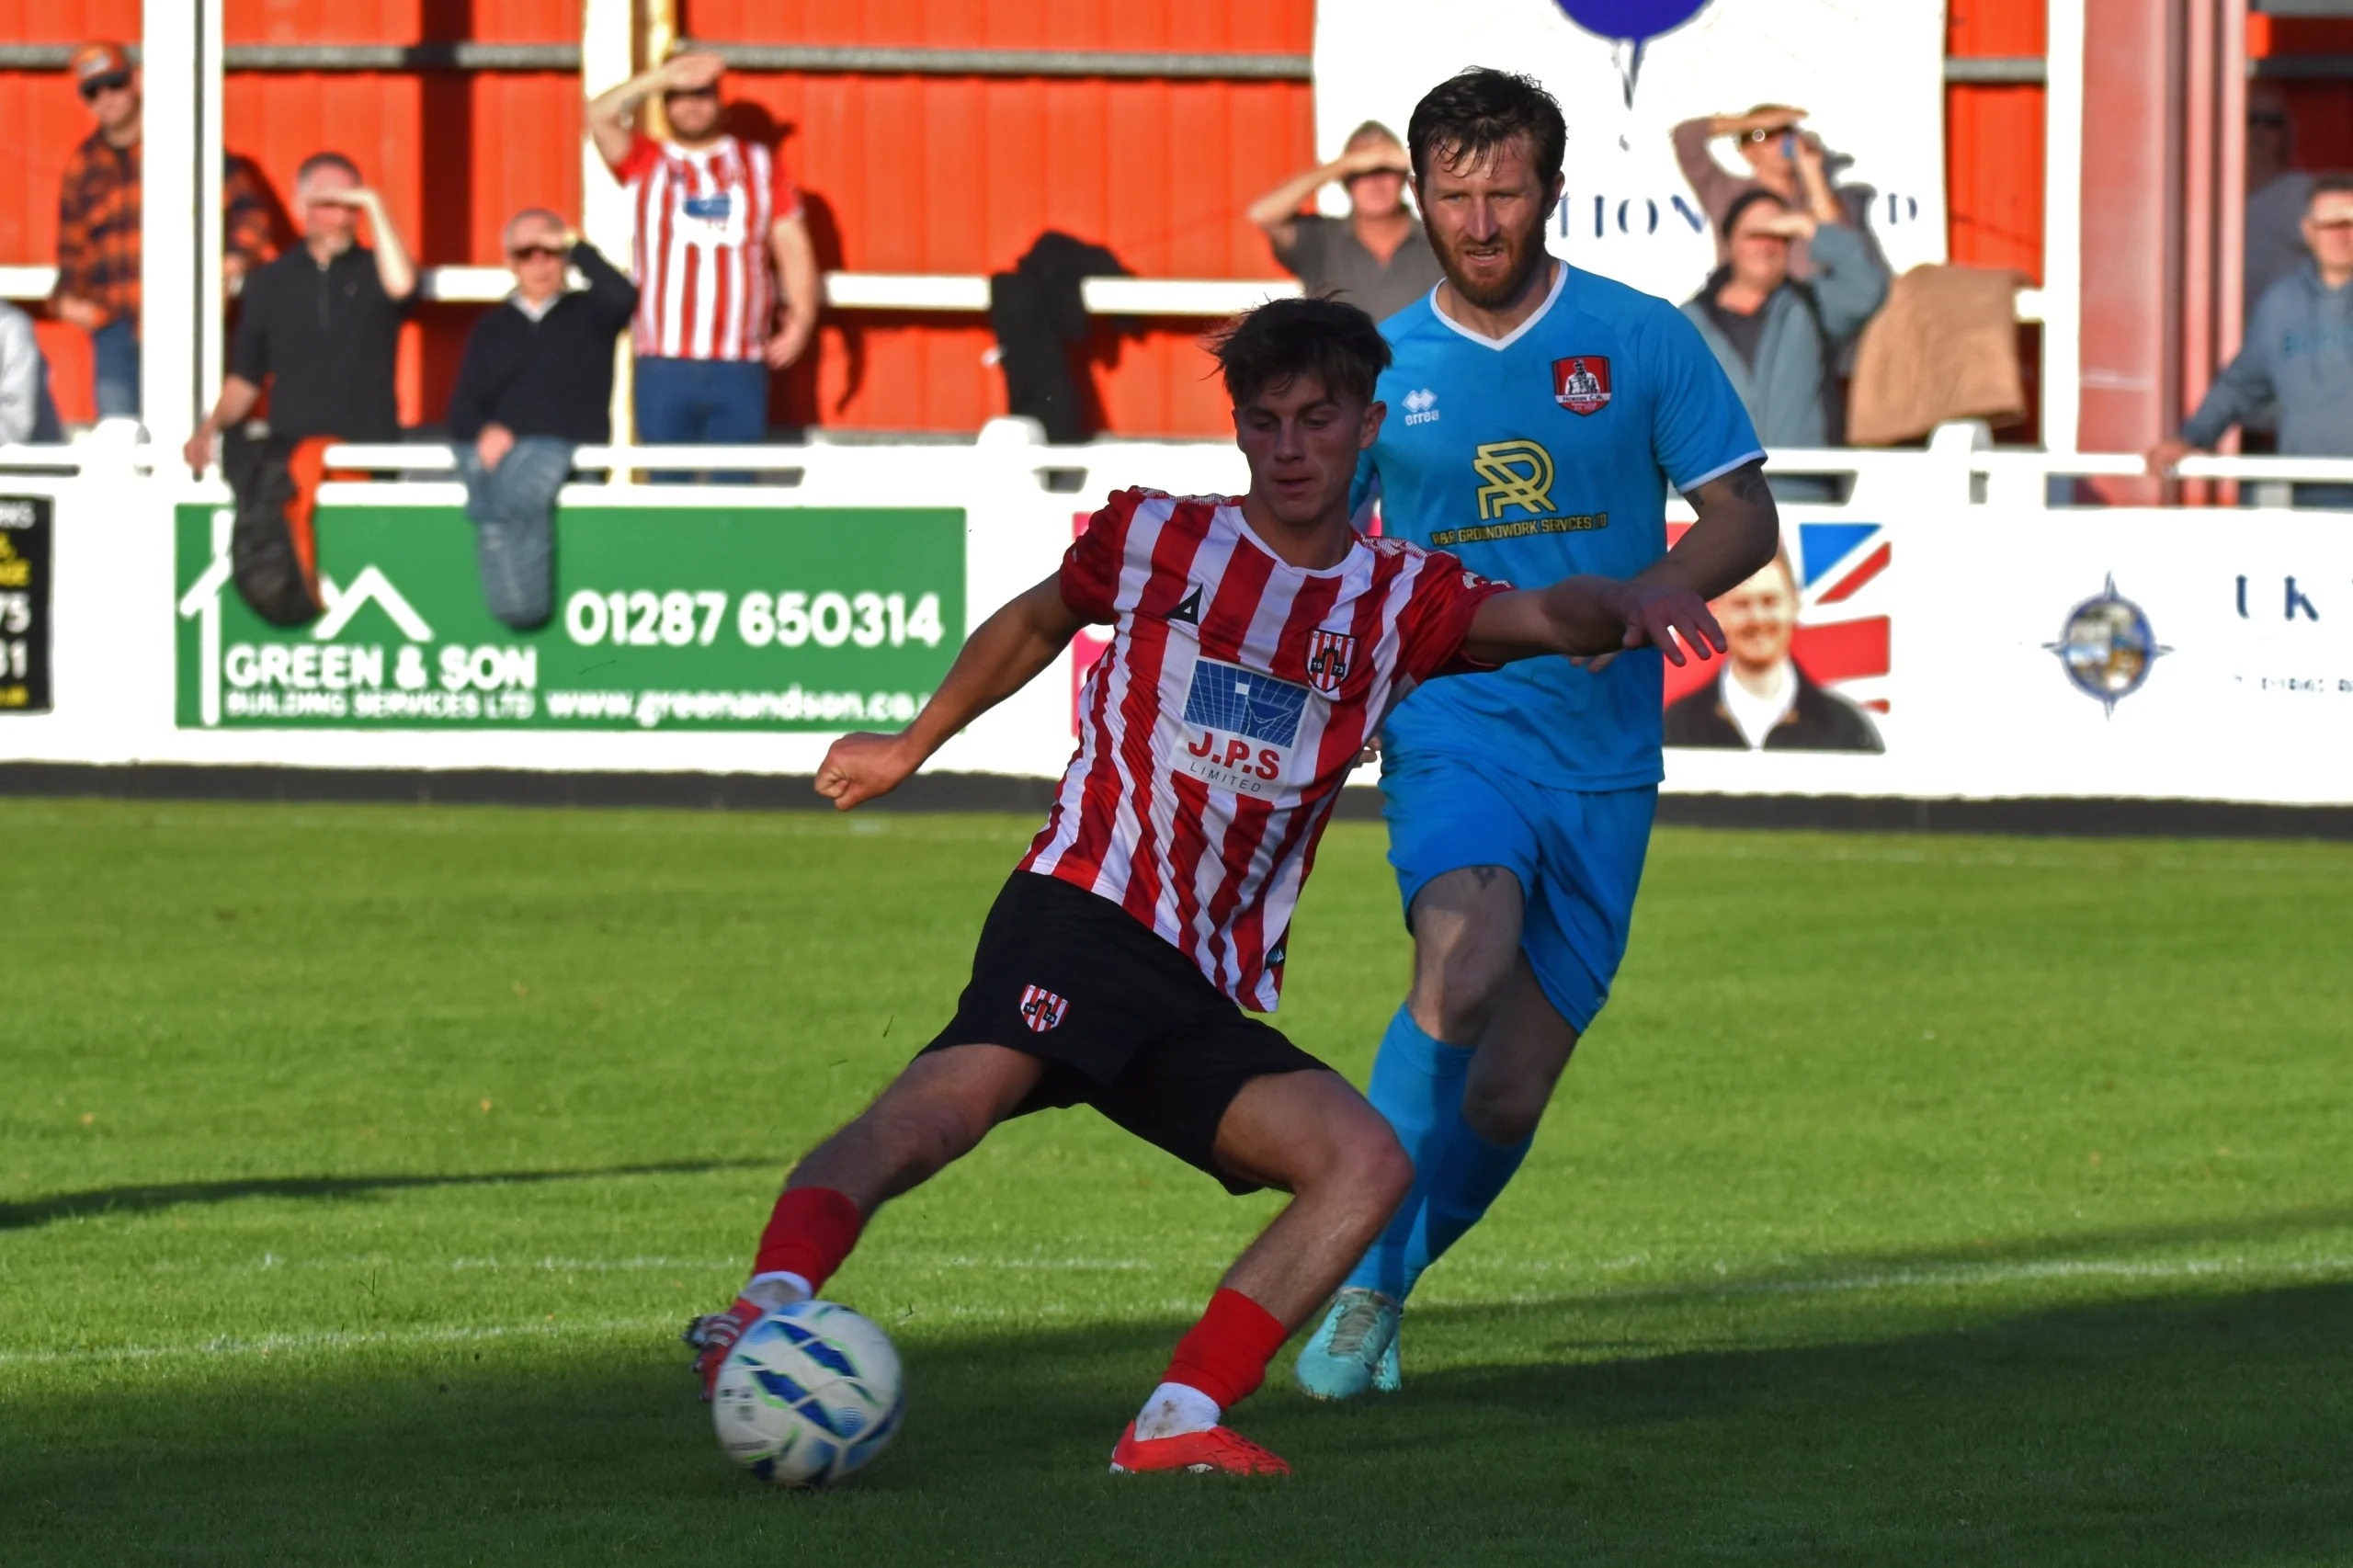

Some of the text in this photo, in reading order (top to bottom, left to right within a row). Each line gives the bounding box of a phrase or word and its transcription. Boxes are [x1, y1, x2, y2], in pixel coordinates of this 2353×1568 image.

[1405, 410, 1440, 426] errea
[564, 588, 946, 648] 01287 650314
[224, 643, 539, 690] GREEN & SON
[351, 691, 481, 719] SERVICES
[483, 691, 537, 720] LTD
[545, 684, 932, 728] www.greenandson.co.
[1188, 731, 1281, 781] J.P.S
[1189, 761, 1262, 792] LIMITED
